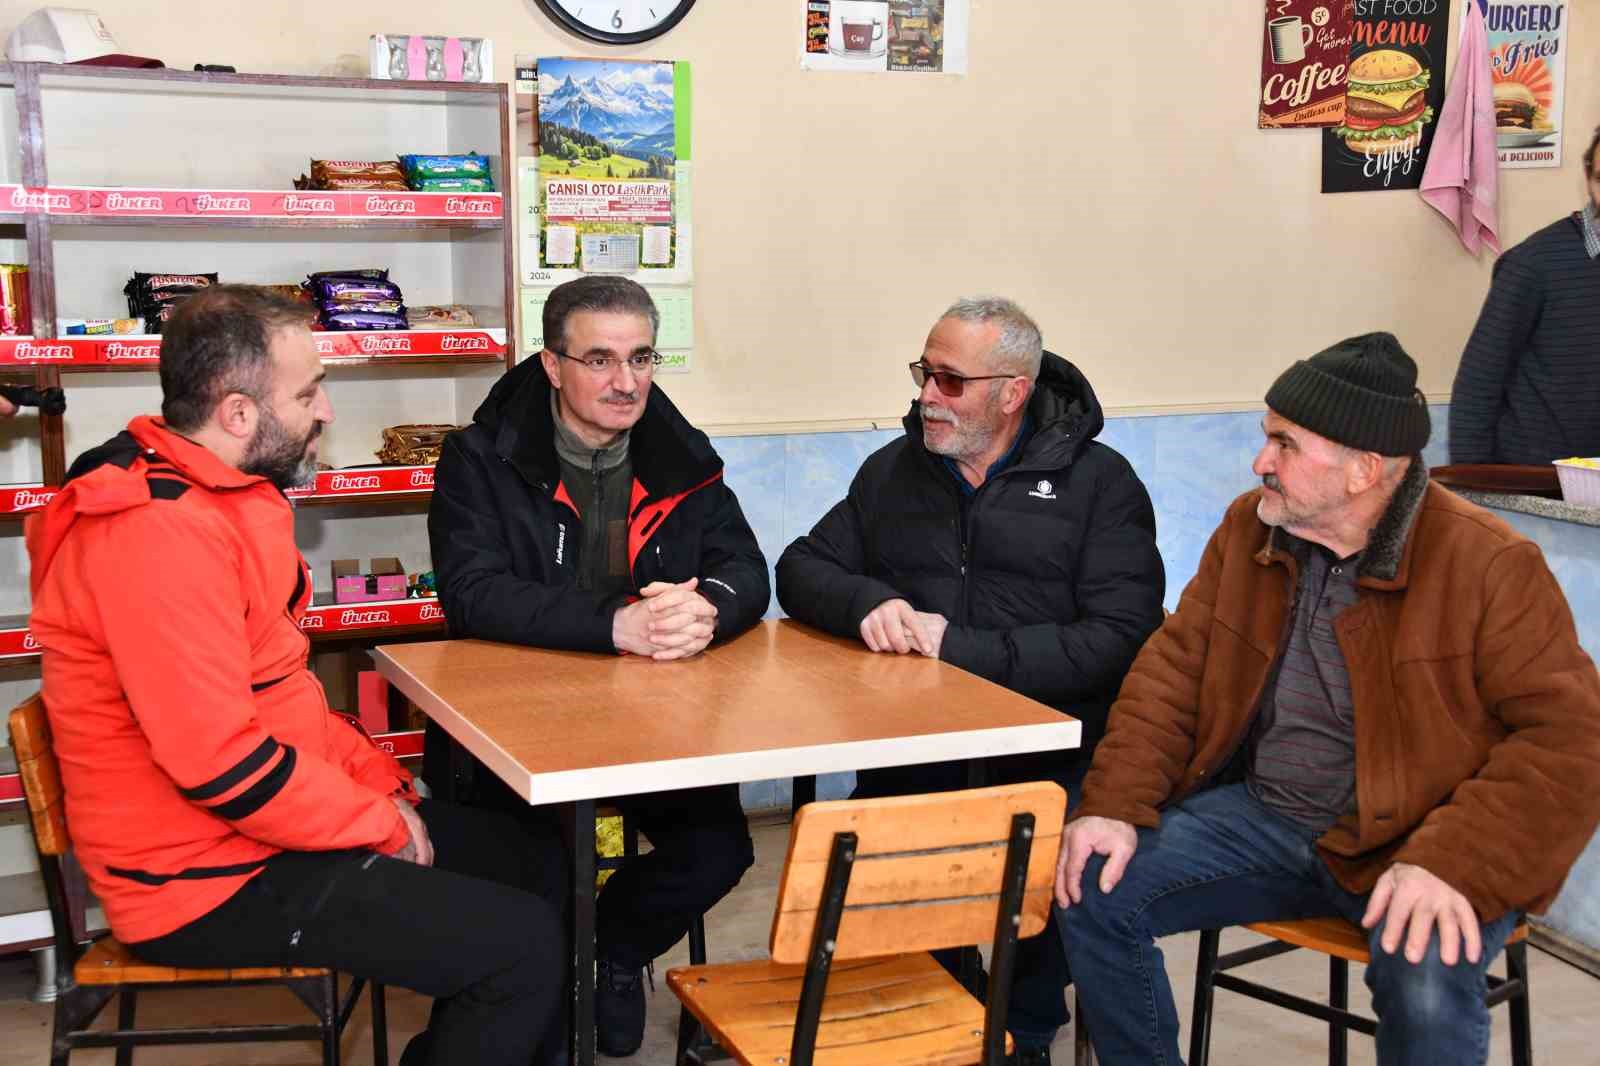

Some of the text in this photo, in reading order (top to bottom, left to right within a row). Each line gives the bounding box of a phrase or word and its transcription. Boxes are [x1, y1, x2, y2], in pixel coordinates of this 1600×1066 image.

[1384, 0, 1437, 15] FOOD
[611, 9, 623, 29] 6
[1316, 28, 1336, 47] Get
[1503, 35, 1559, 75] Fries
[1263, 62, 1346, 107] Coffee
[1294, 103, 1343, 121] Endless cup
[1363, 121, 1423, 187] Enjoy!
[1509, 151, 1555, 162] DELICIOUS
[592, 183, 615, 195] OTO
[13, 189, 71, 208] ÜLKER
[106, 193, 163, 210] ÜLKER
[197, 193, 251, 210] ÜLKER
[284, 195, 335, 212] ÜLKER
[367, 196, 415, 213] ÜLKER
[445, 197, 494, 213] ÜLKER
[530, 272, 551, 281] 2024
[15, 342, 73, 360] ÜLKER
[362, 335, 411, 351] ÜLKER
[441, 336, 489, 350] ÜLKER
[331, 474, 380, 491] ÜLKER
[341, 610, 390, 626] ÜLKER
